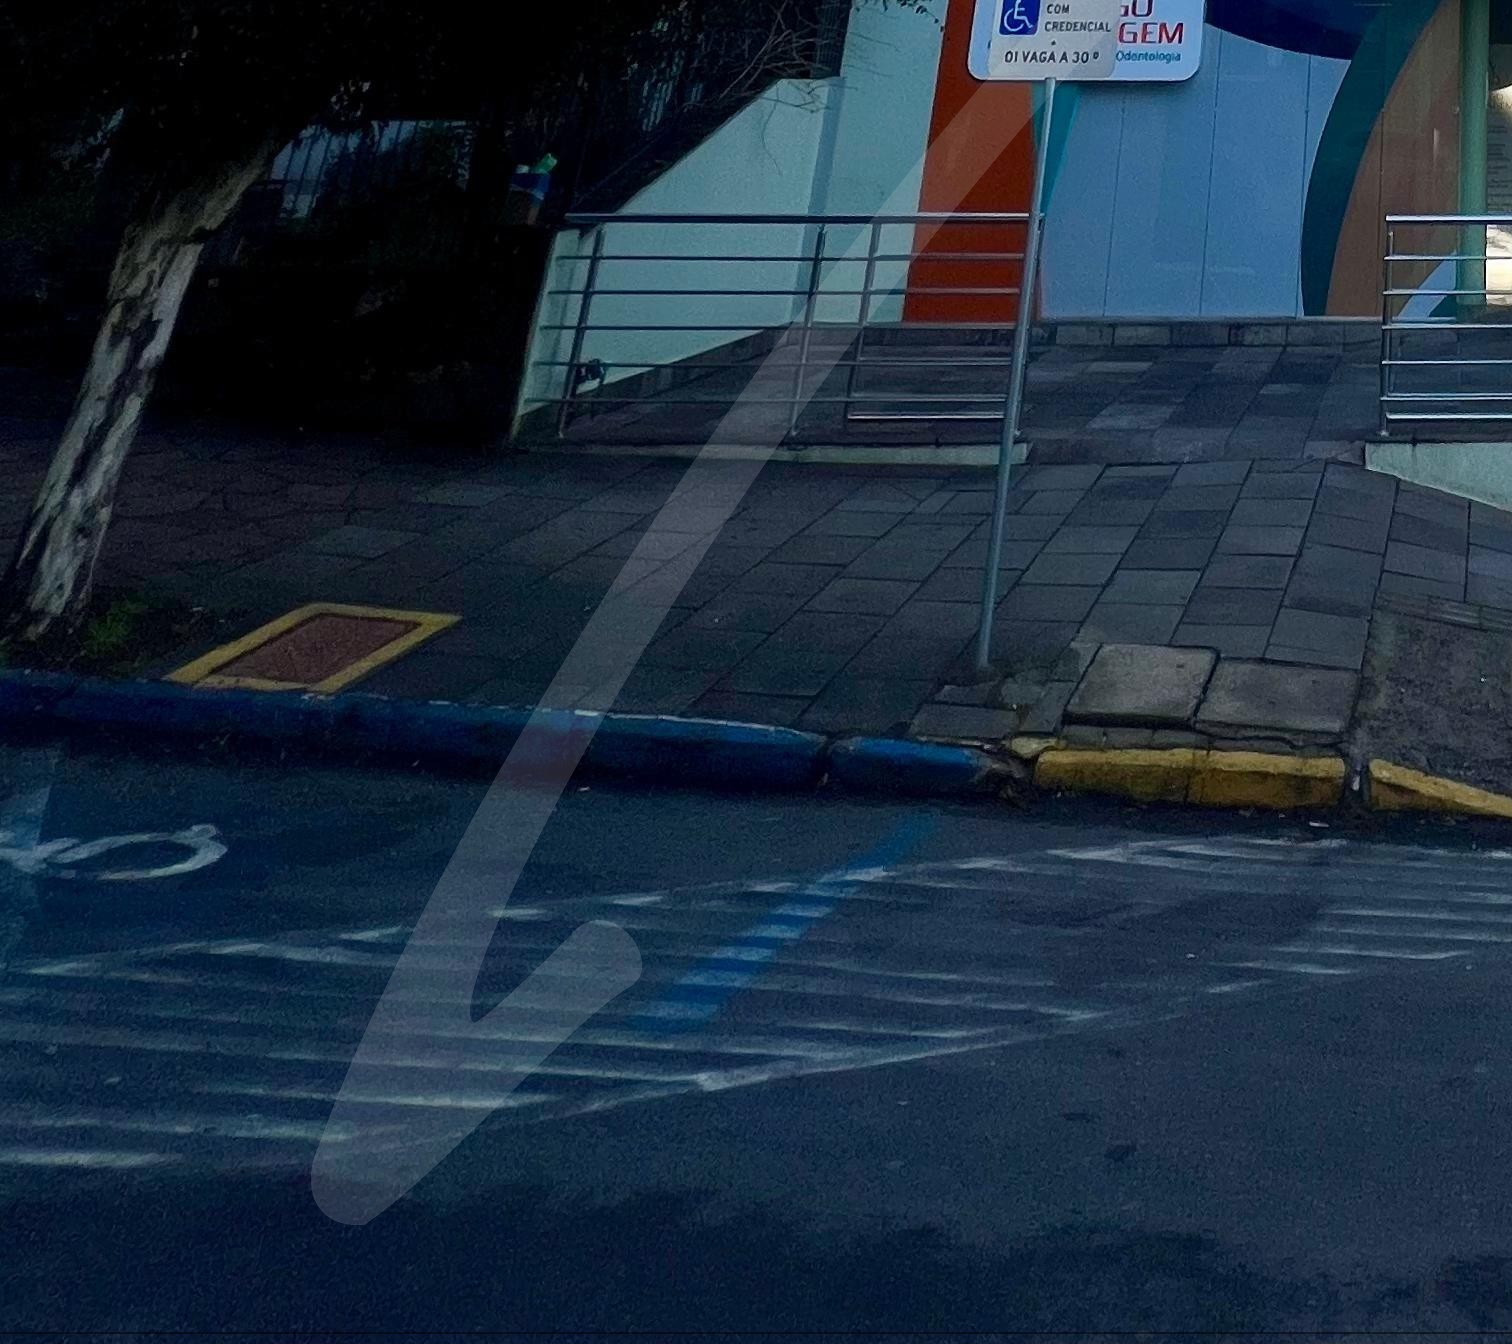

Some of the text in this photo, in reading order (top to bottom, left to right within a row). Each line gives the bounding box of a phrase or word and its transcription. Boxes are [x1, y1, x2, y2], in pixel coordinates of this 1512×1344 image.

[1046, 3, 1070, 15] COM
[1044, 20, 1112, 33] CREDENCIAL
[1022, 50, 1056, 64] VAGA
[1059, 50, 1069, 64] A
[1115, 50, 1182, 65] Odontologia
